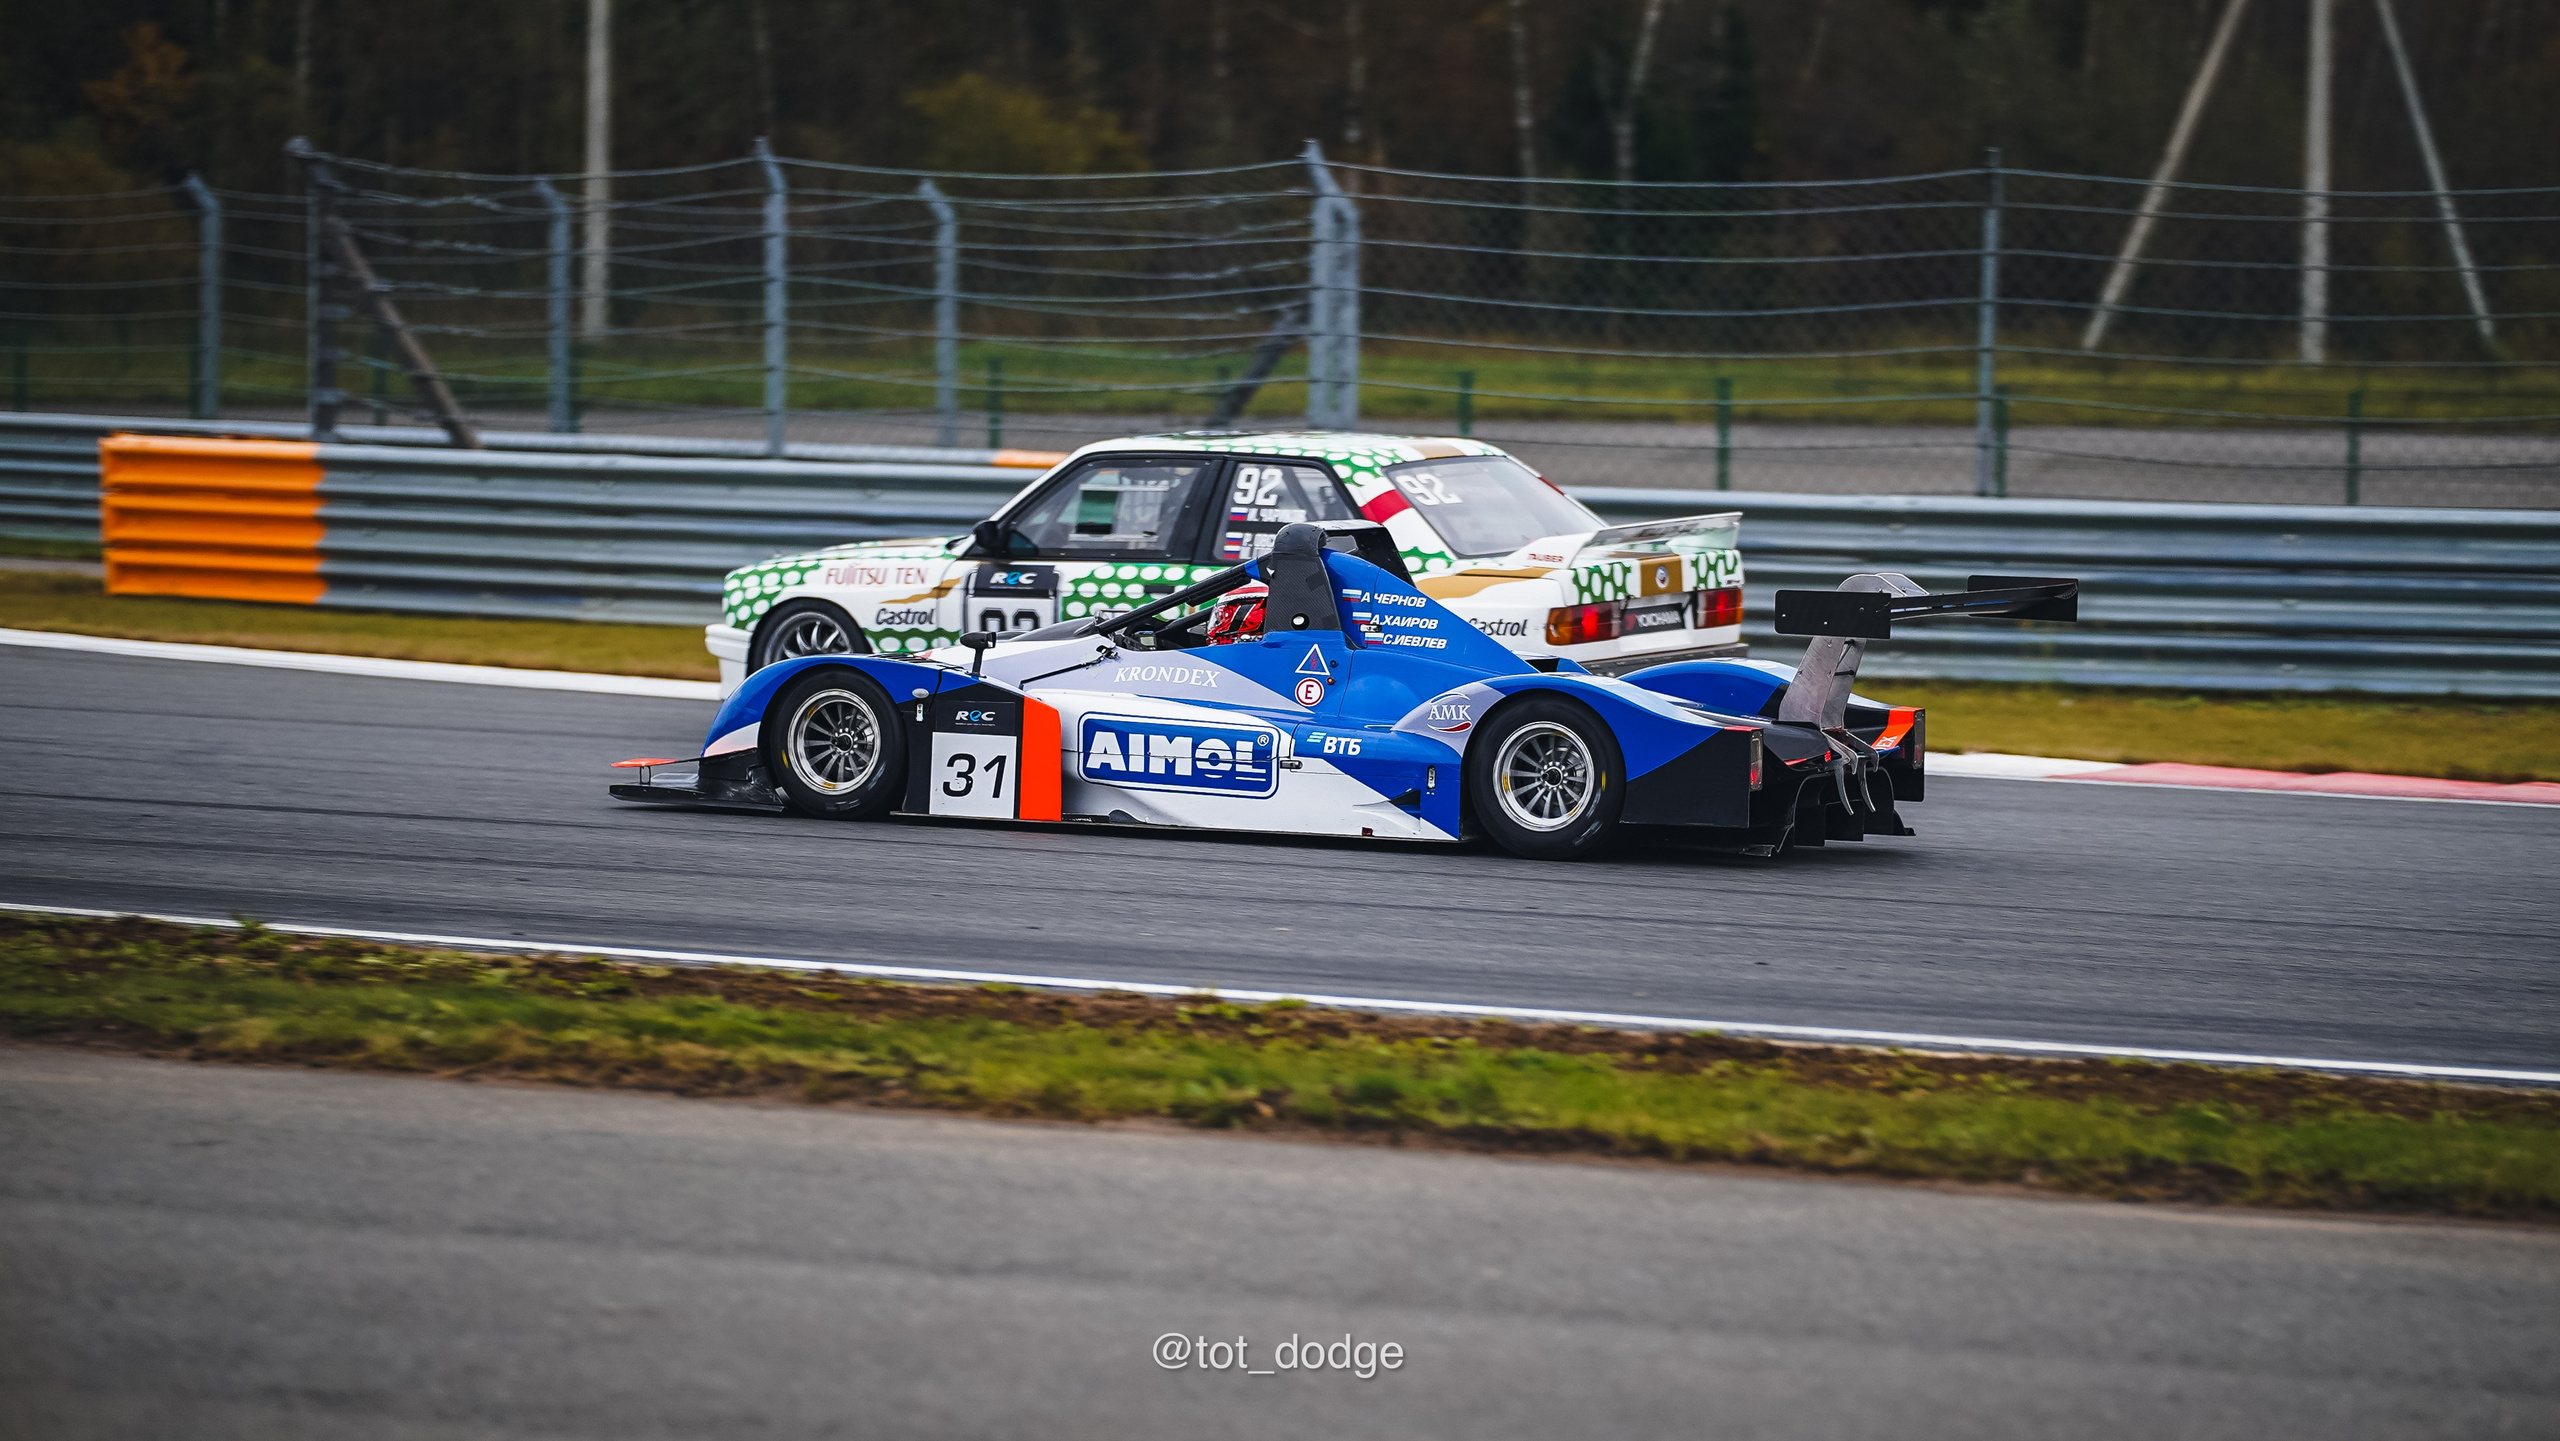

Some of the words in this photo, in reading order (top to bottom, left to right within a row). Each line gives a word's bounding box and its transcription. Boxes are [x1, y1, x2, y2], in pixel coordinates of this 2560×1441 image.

[1233, 467, 1283, 506] 92
[1395, 473, 1463, 506] 92
[894, 567, 927, 585] TEN
[1373, 593, 1427, 608] ЧЕРНОВ
[875, 607, 935, 625] Castrol
[1114, 665, 1221, 688] KRONDEX
[942, 752, 1008, 799] 31
